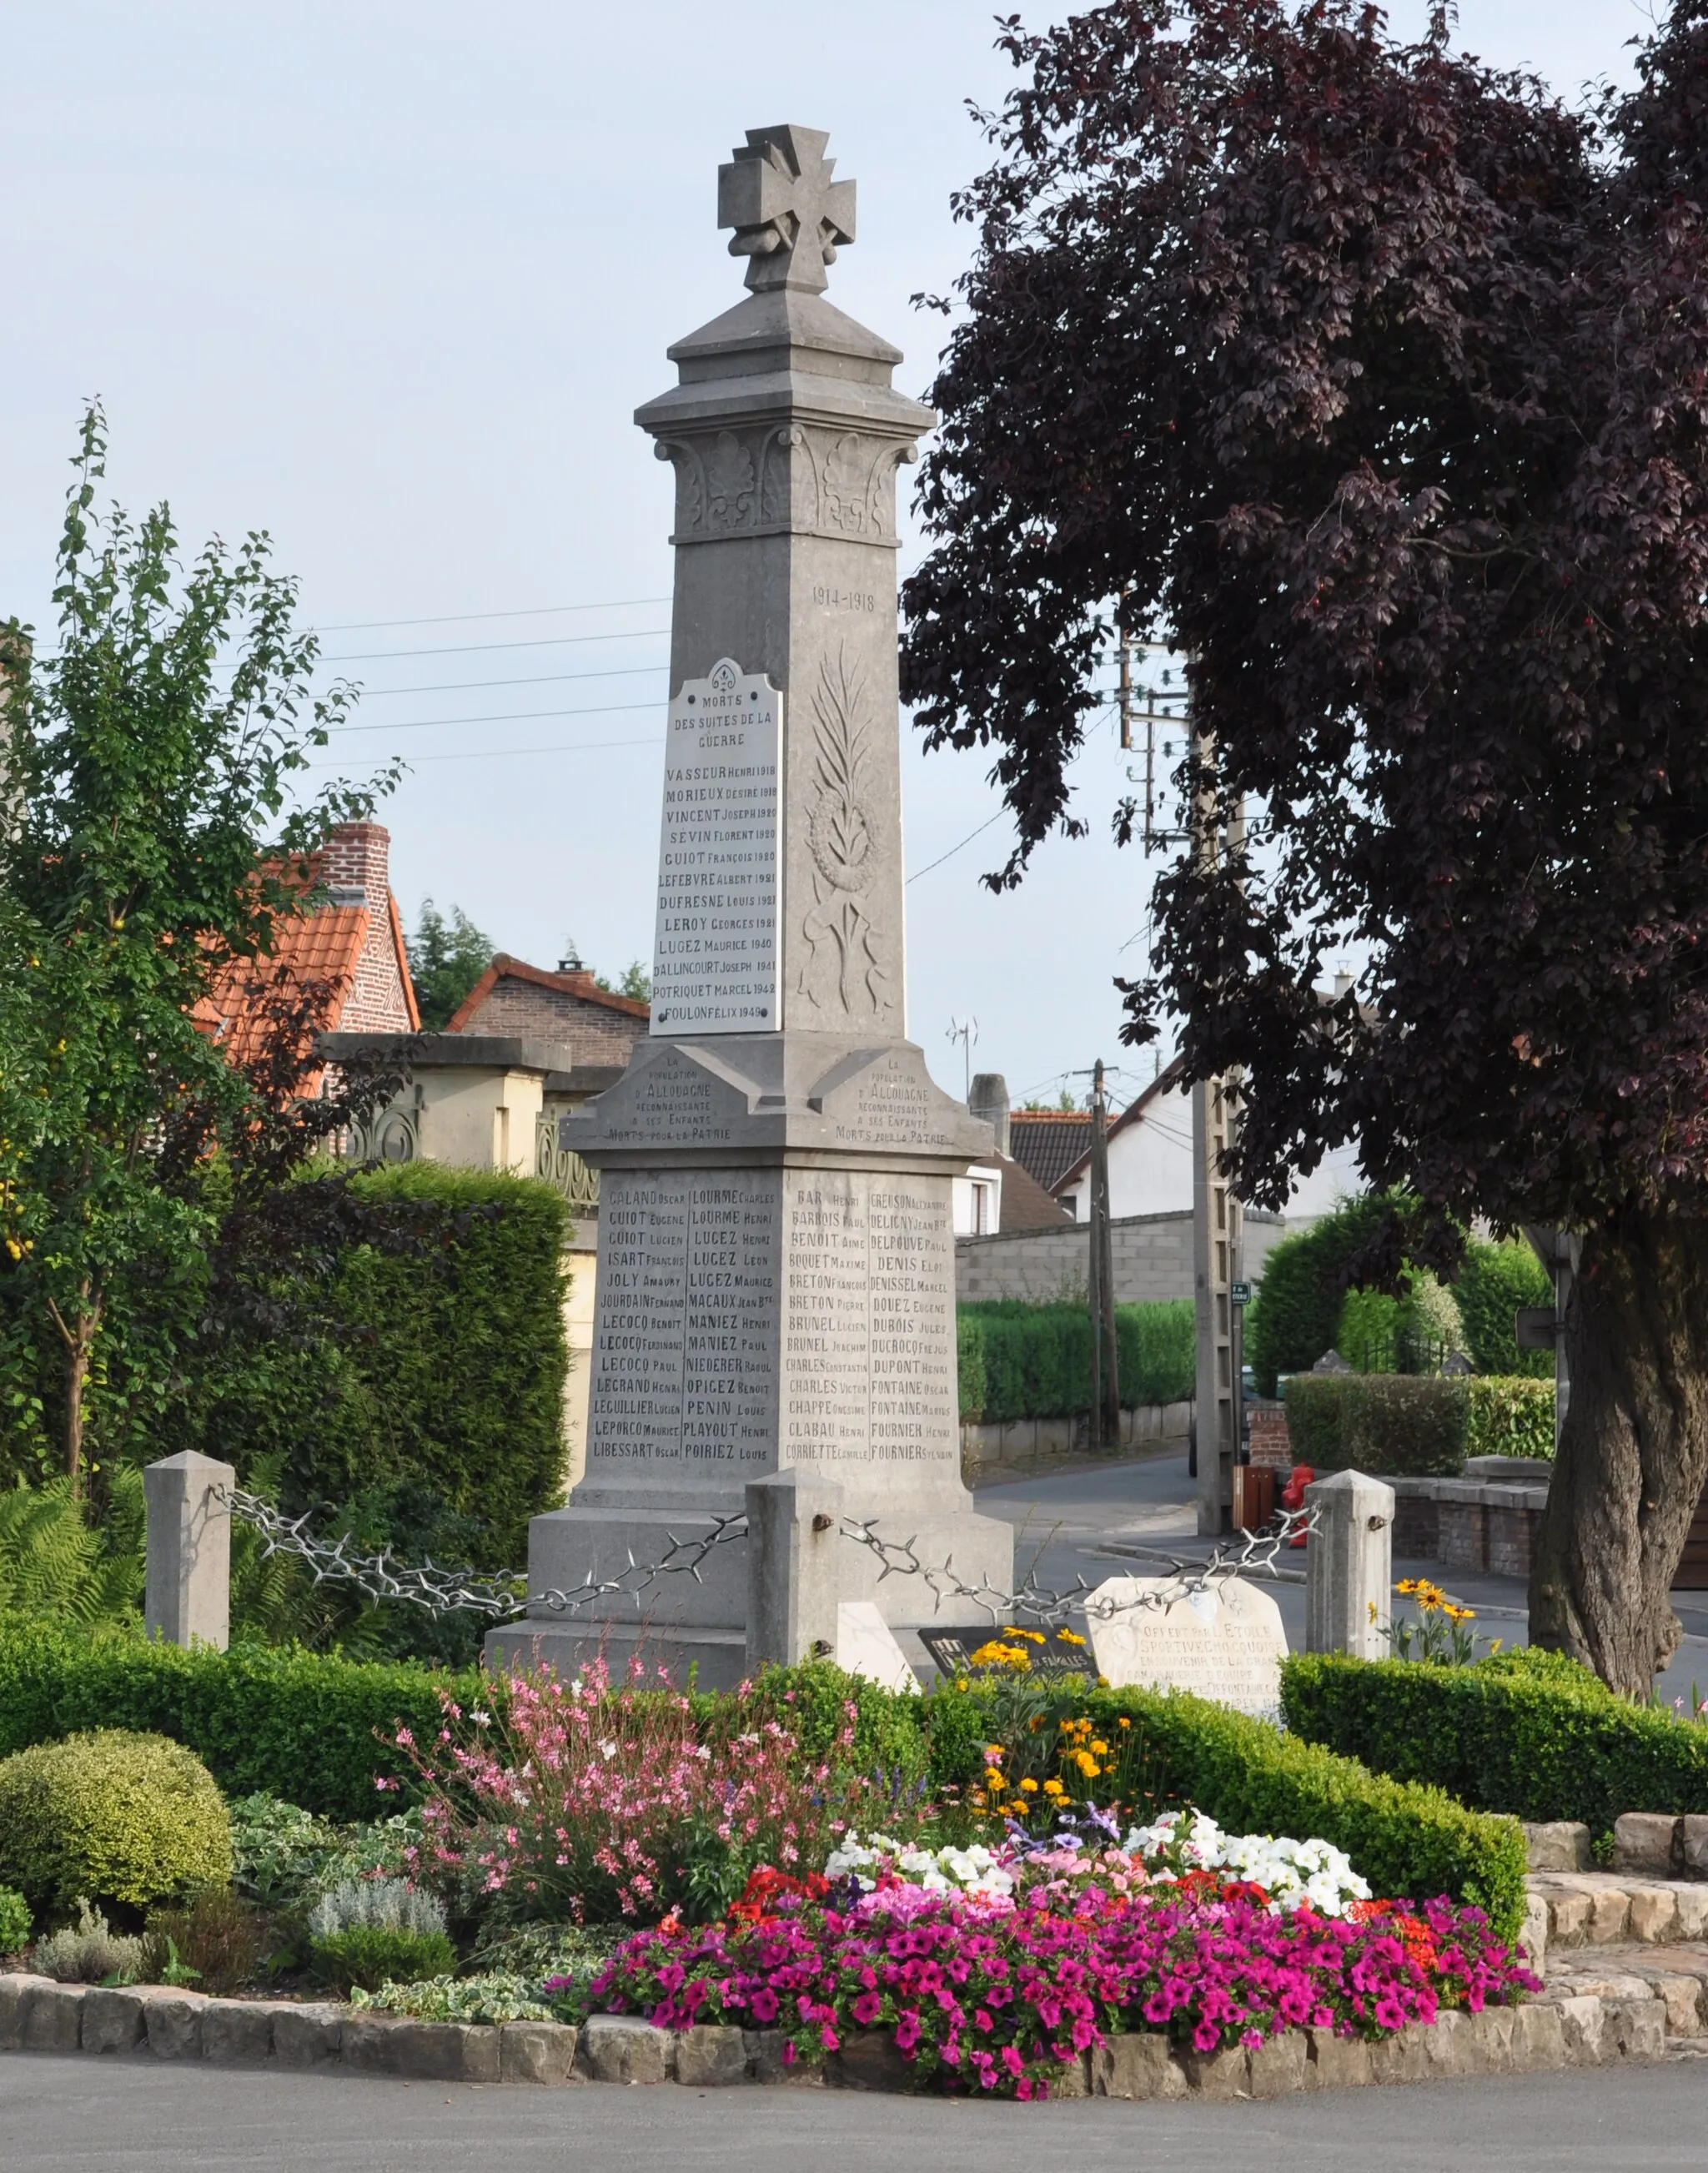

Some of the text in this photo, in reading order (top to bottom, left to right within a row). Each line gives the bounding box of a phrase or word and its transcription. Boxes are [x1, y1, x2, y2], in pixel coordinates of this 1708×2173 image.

[813, 587, 874, 612] 1914-1918
[703, 695, 741, 707] MORTS
[675, 712, 771, 730] DES SUITES DE LA
[699, 734, 744, 747] GUERRE
[667, 766, 776, 781] VASSEUR HENRI 1918
[666, 787, 776, 802] MORIEUX 1918
[667, 809, 720, 822] VINCENT
[722, 809, 755, 820] JOSEPH
[714, 830, 753, 842] FLORENT
[666, 853, 705, 865] GUIOT
[659, 873, 774, 887] LEFEBVRE ALBERT 1921
[660, 895, 775, 909] DUFRESNE LOUIS 1921
[666, 918, 774, 931] LEROY GEORGES 1921
[660, 939, 771, 954] LUGEZ MAURICE 1940
[721, 962, 775, 973] JOSEPH 1941
[653, 985, 711, 998] POTRIQUET
[715, 985, 751, 996] MARCEL
[666, 1008, 708, 1020] FOULON
[636, 1102, 710, 1111] RECONNAISSANTE
[836, 1126, 872, 1141] MORTS
[693, 1190, 738, 1204] LOURME
[692, 1211, 740, 1224] LOURME
[608, 1252, 645, 1266] ISART
[878, 1257, 917, 1271] DENIS
[607, 1274, 639, 1287] JOLY
[871, 1277, 917, 1292] DENISSEL
[600, 1295, 650, 1309] JOURDAIN
[690, 1295, 736, 1308] MACAUX
[874, 1298, 910, 1313] DOUEZ
[603, 1315, 648, 1331] LECOCQ
[690, 1315, 738, 1329] MANIEZ
[789, 1316, 836, 1331] BRUNEL
[600, 1335, 641, 1352] LECOCQ
[689, 1336, 737, 1351] MANIEZ
[787, 1338, 828, 1352] BRUNEL
[602, 1357, 649, 1373] LECOCQ
[786, 1359, 825, 1372] CHARLES
[875, 1360, 921, 1374] DUPONT
[790, 1380, 837, 1394] CHARLES
[872, 1381, 922, 1395] FONTAINE
[688, 1401, 731, 1415] PENIN
[872, 1401, 922, 1416] FONTAINE
[595, 1421, 642, 1436] LEPORCO
[684, 1422, 738, 1437] PLAYOUT
[790, 1422, 834, 1437] CLABAU
[872, 1423, 922, 1438] FOURNIER
[594, 1442, 654, 1457] LIBESSART
[686, 1444, 735, 1459] POIRIEZ
[872, 1445, 922, 1460] FOURNIER
